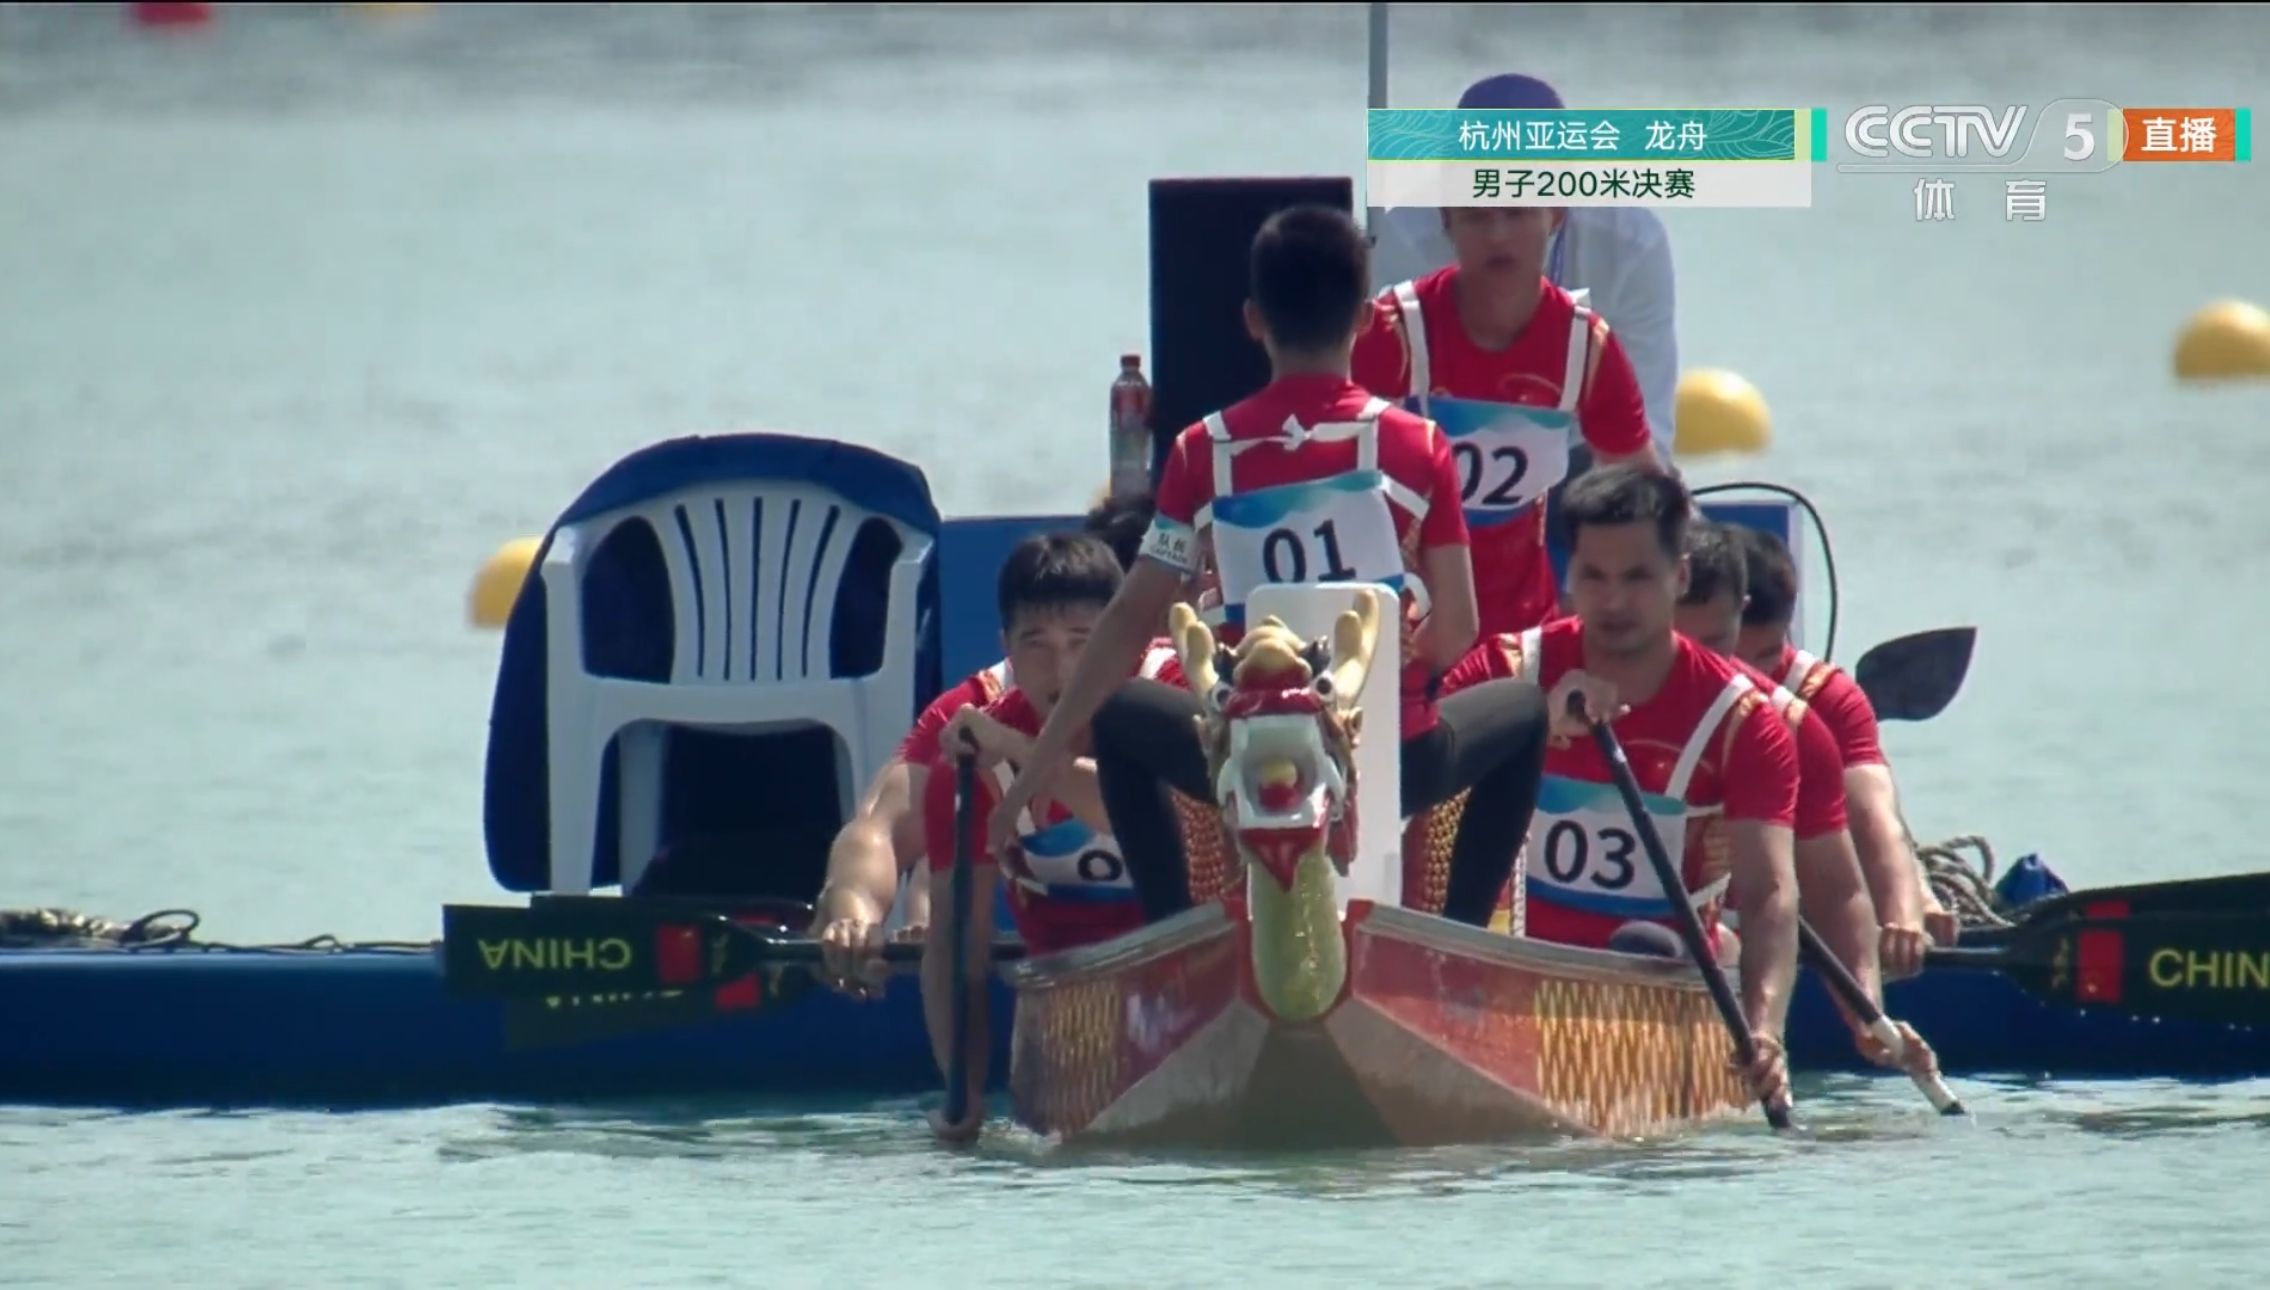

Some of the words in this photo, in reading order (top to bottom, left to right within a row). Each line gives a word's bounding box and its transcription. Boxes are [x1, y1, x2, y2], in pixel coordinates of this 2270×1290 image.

[1451, 441, 1529, 506] 02
[1263, 517, 1357, 584] 01
[1077, 849, 1123, 883] 0
[1544, 819, 1635, 891] 03
[477, 938, 632, 970] CHINA
[2149, 948, 2270, 989] CHIN
